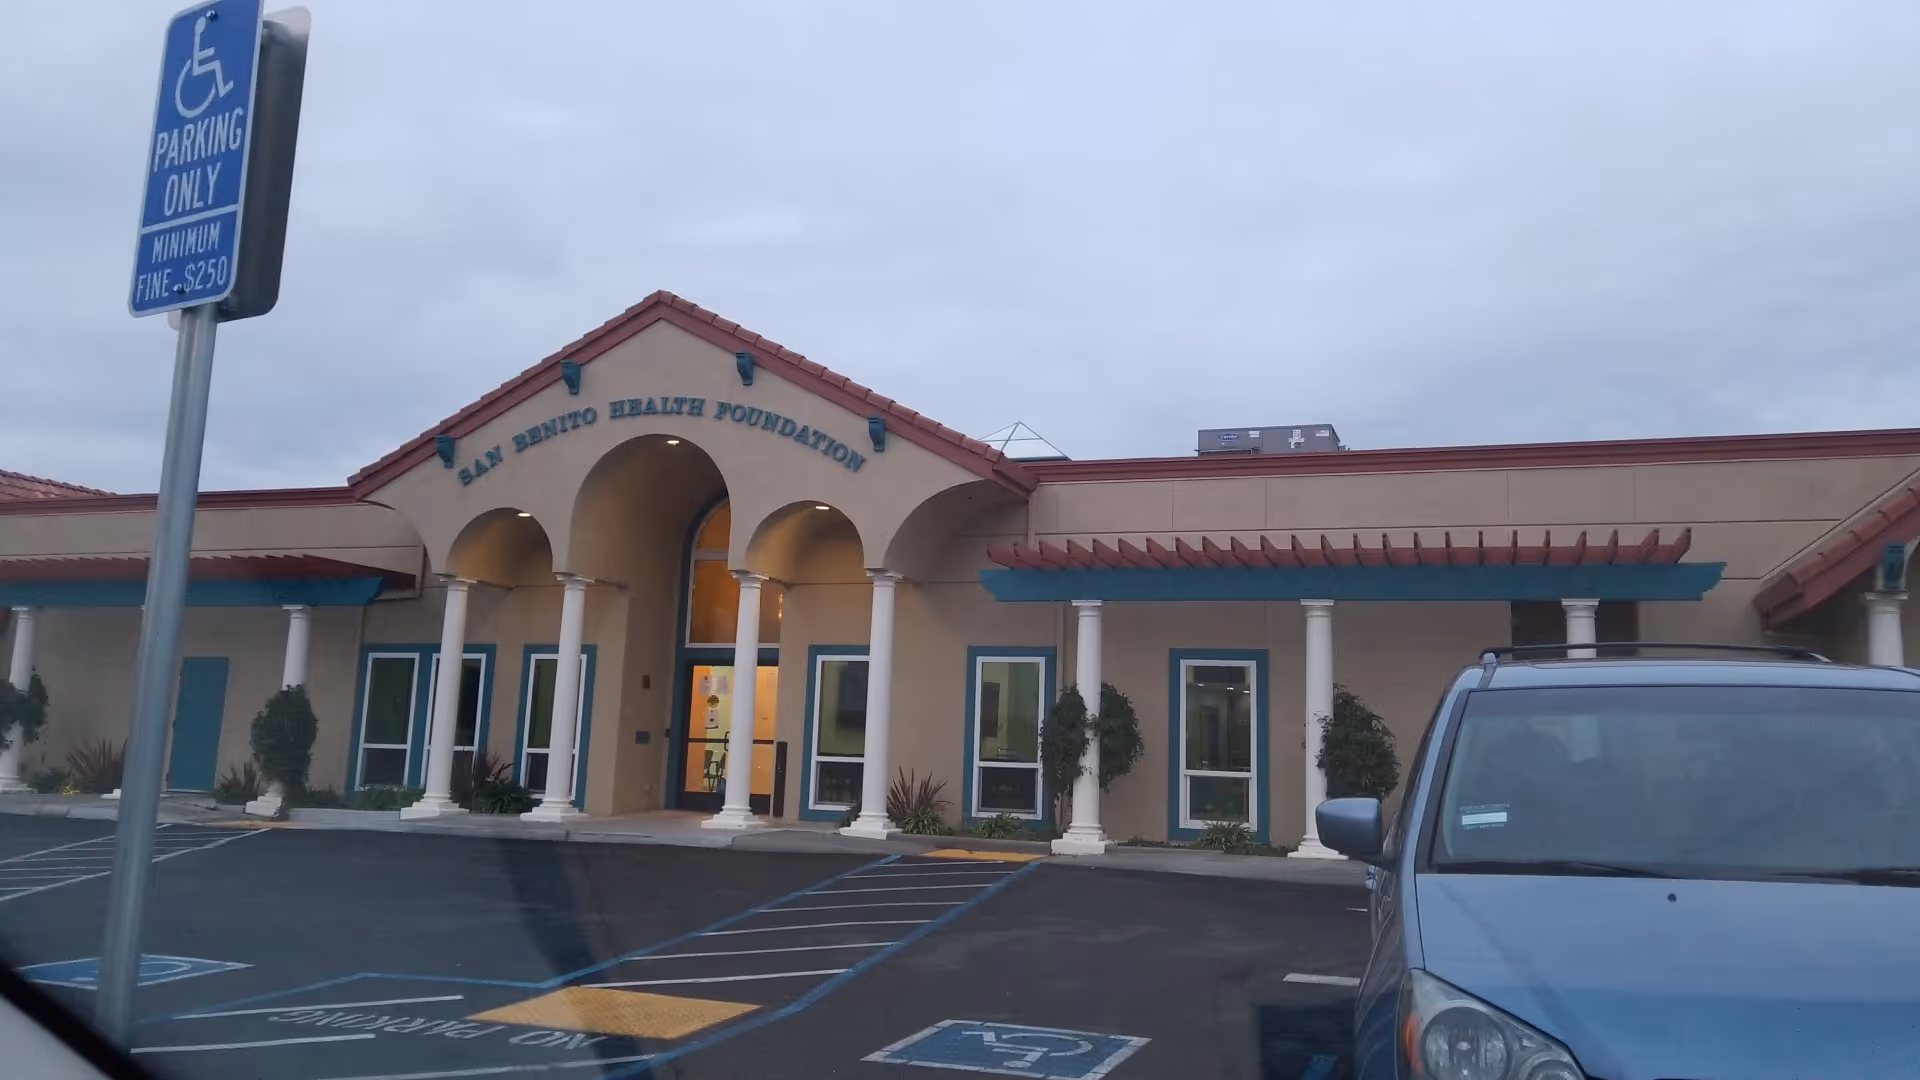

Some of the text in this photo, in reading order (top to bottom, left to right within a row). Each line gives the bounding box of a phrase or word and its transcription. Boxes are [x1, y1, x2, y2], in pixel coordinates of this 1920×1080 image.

[154, 107, 244, 172] PARKING
[164, 162, 221, 217] ONLY
[152, 221, 221, 264] MINIMUM
[135, 255, 228, 304] FINE $250
[458, 396, 867, 487] SAN BENITO HEALTH FOUNDATION
[268, 1010, 606, 1050] NO PARKING
